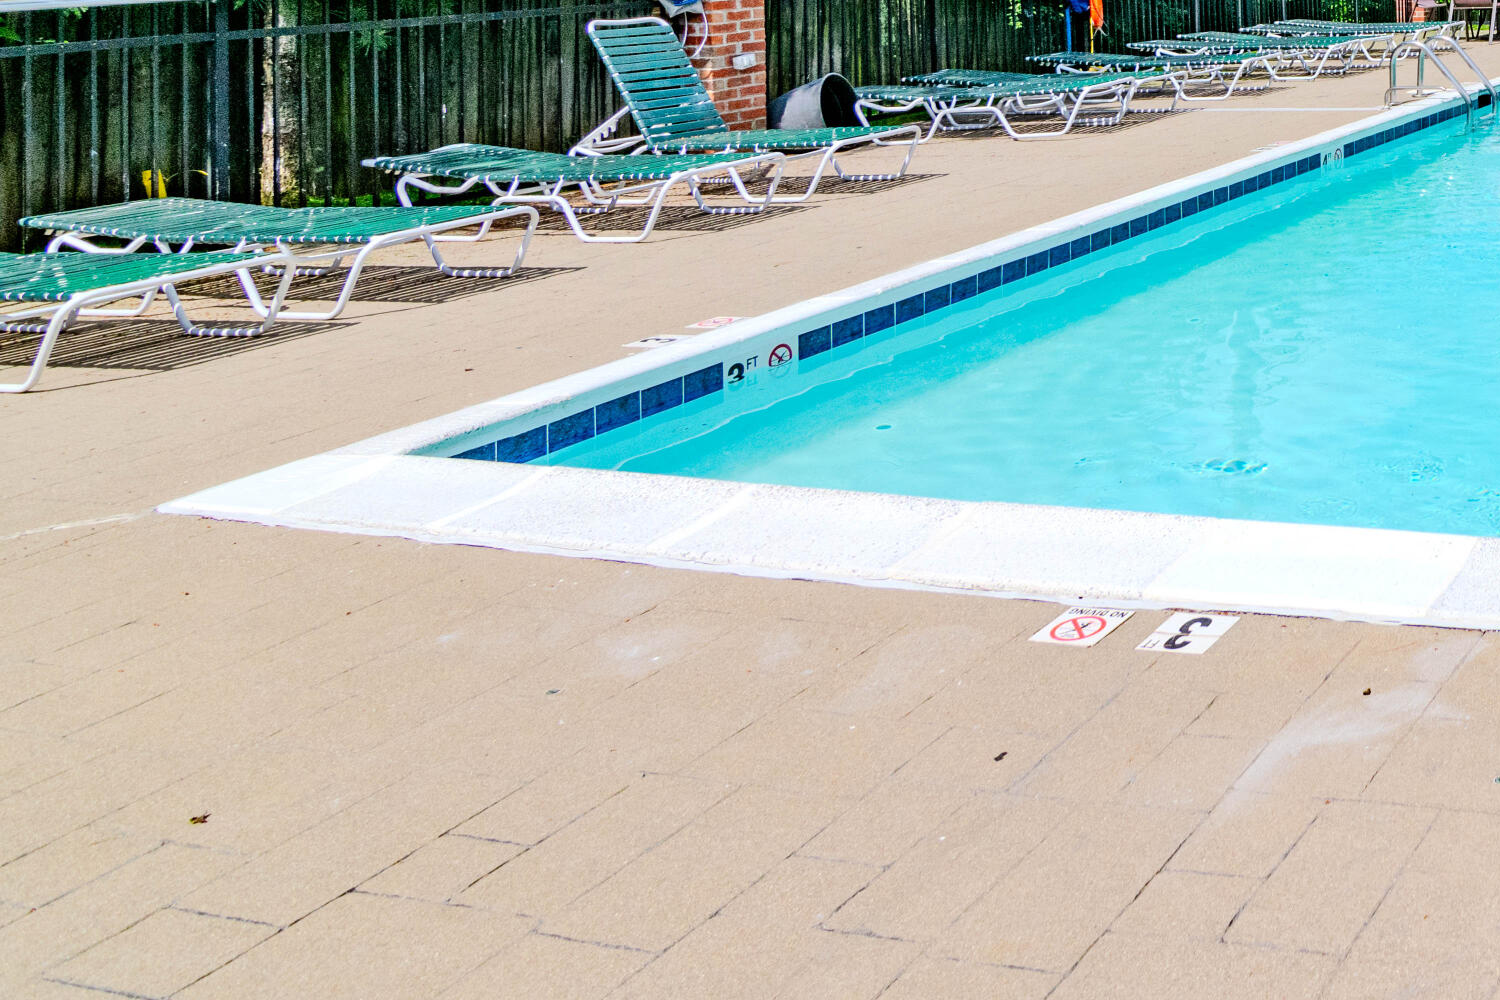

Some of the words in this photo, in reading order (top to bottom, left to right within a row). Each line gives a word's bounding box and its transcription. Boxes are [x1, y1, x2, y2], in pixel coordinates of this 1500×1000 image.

[728, 362, 745, 384] 3
[746, 355, 759, 370] FT
[1070, 607, 1108, 617] DIVING
[1110, 610, 1128, 618] NO
[1163, 617, 1213, 649] 3
